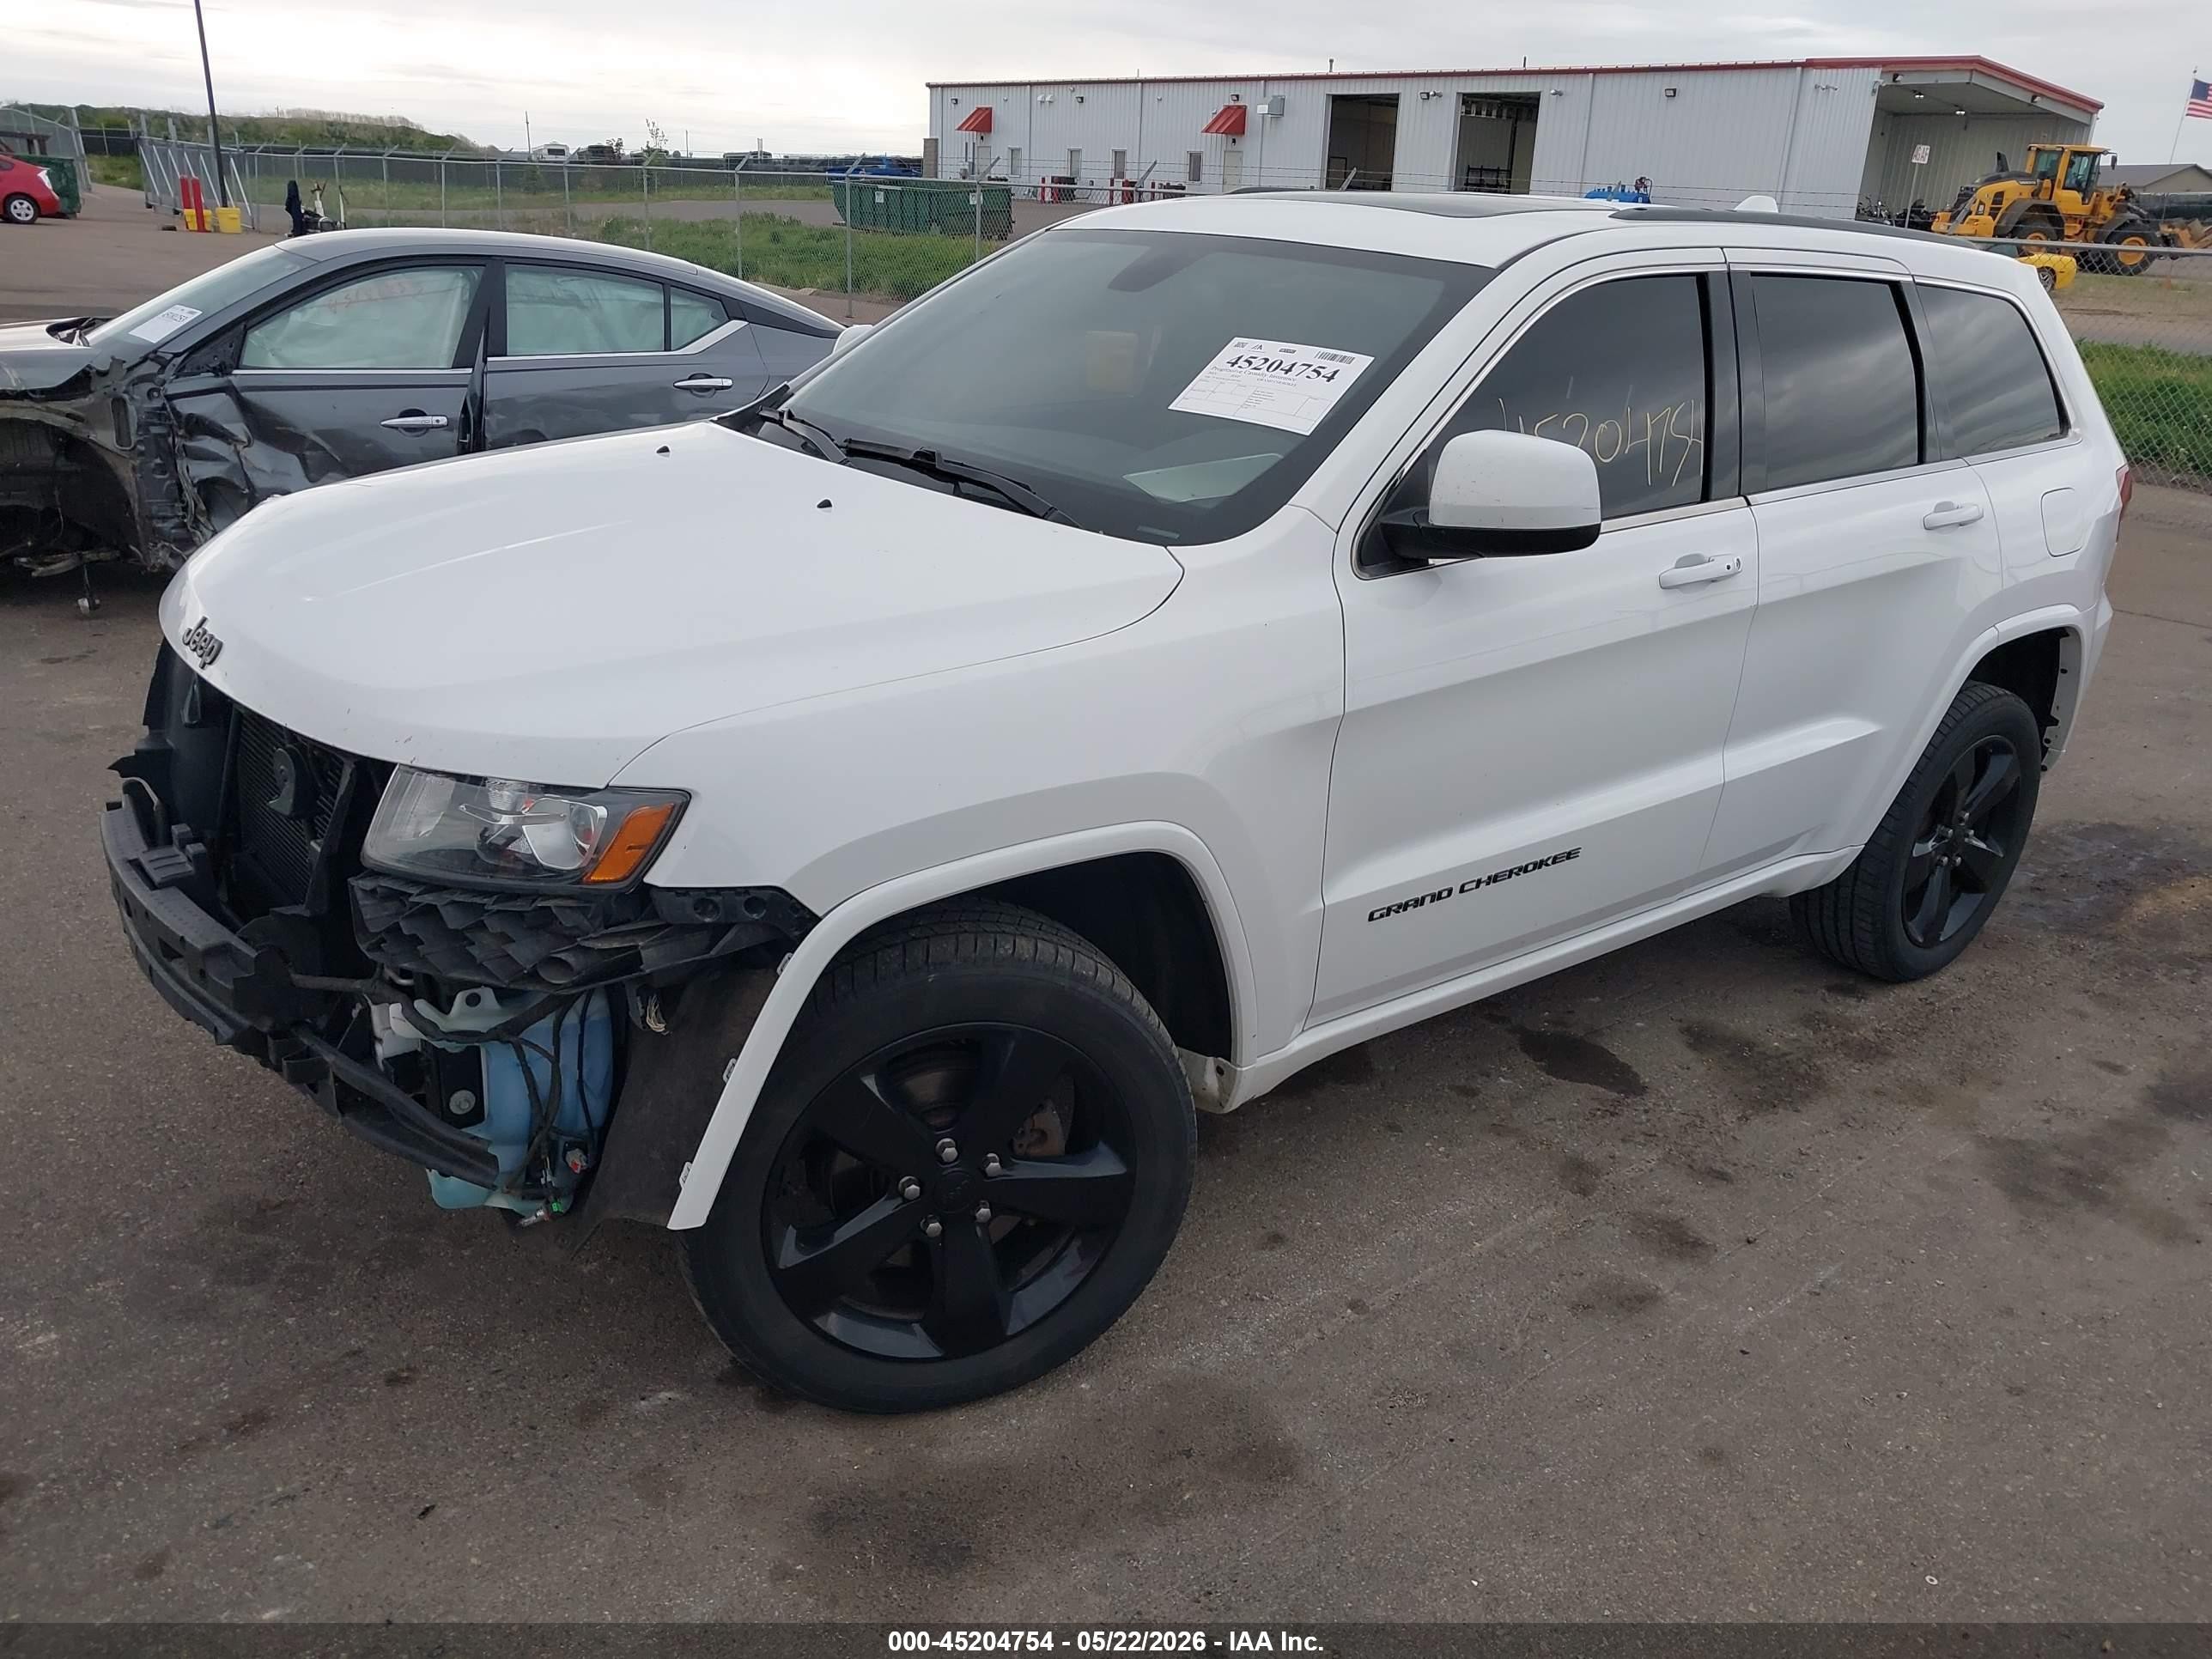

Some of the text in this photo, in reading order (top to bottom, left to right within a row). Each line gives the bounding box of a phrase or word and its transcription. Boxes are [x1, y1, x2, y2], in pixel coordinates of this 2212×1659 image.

[1226, 354, 1340, 383] 45204754
[181, 616, 223, 670] Jeep
[1367, 847, 1583, 922] GRAND CHEROKEE
